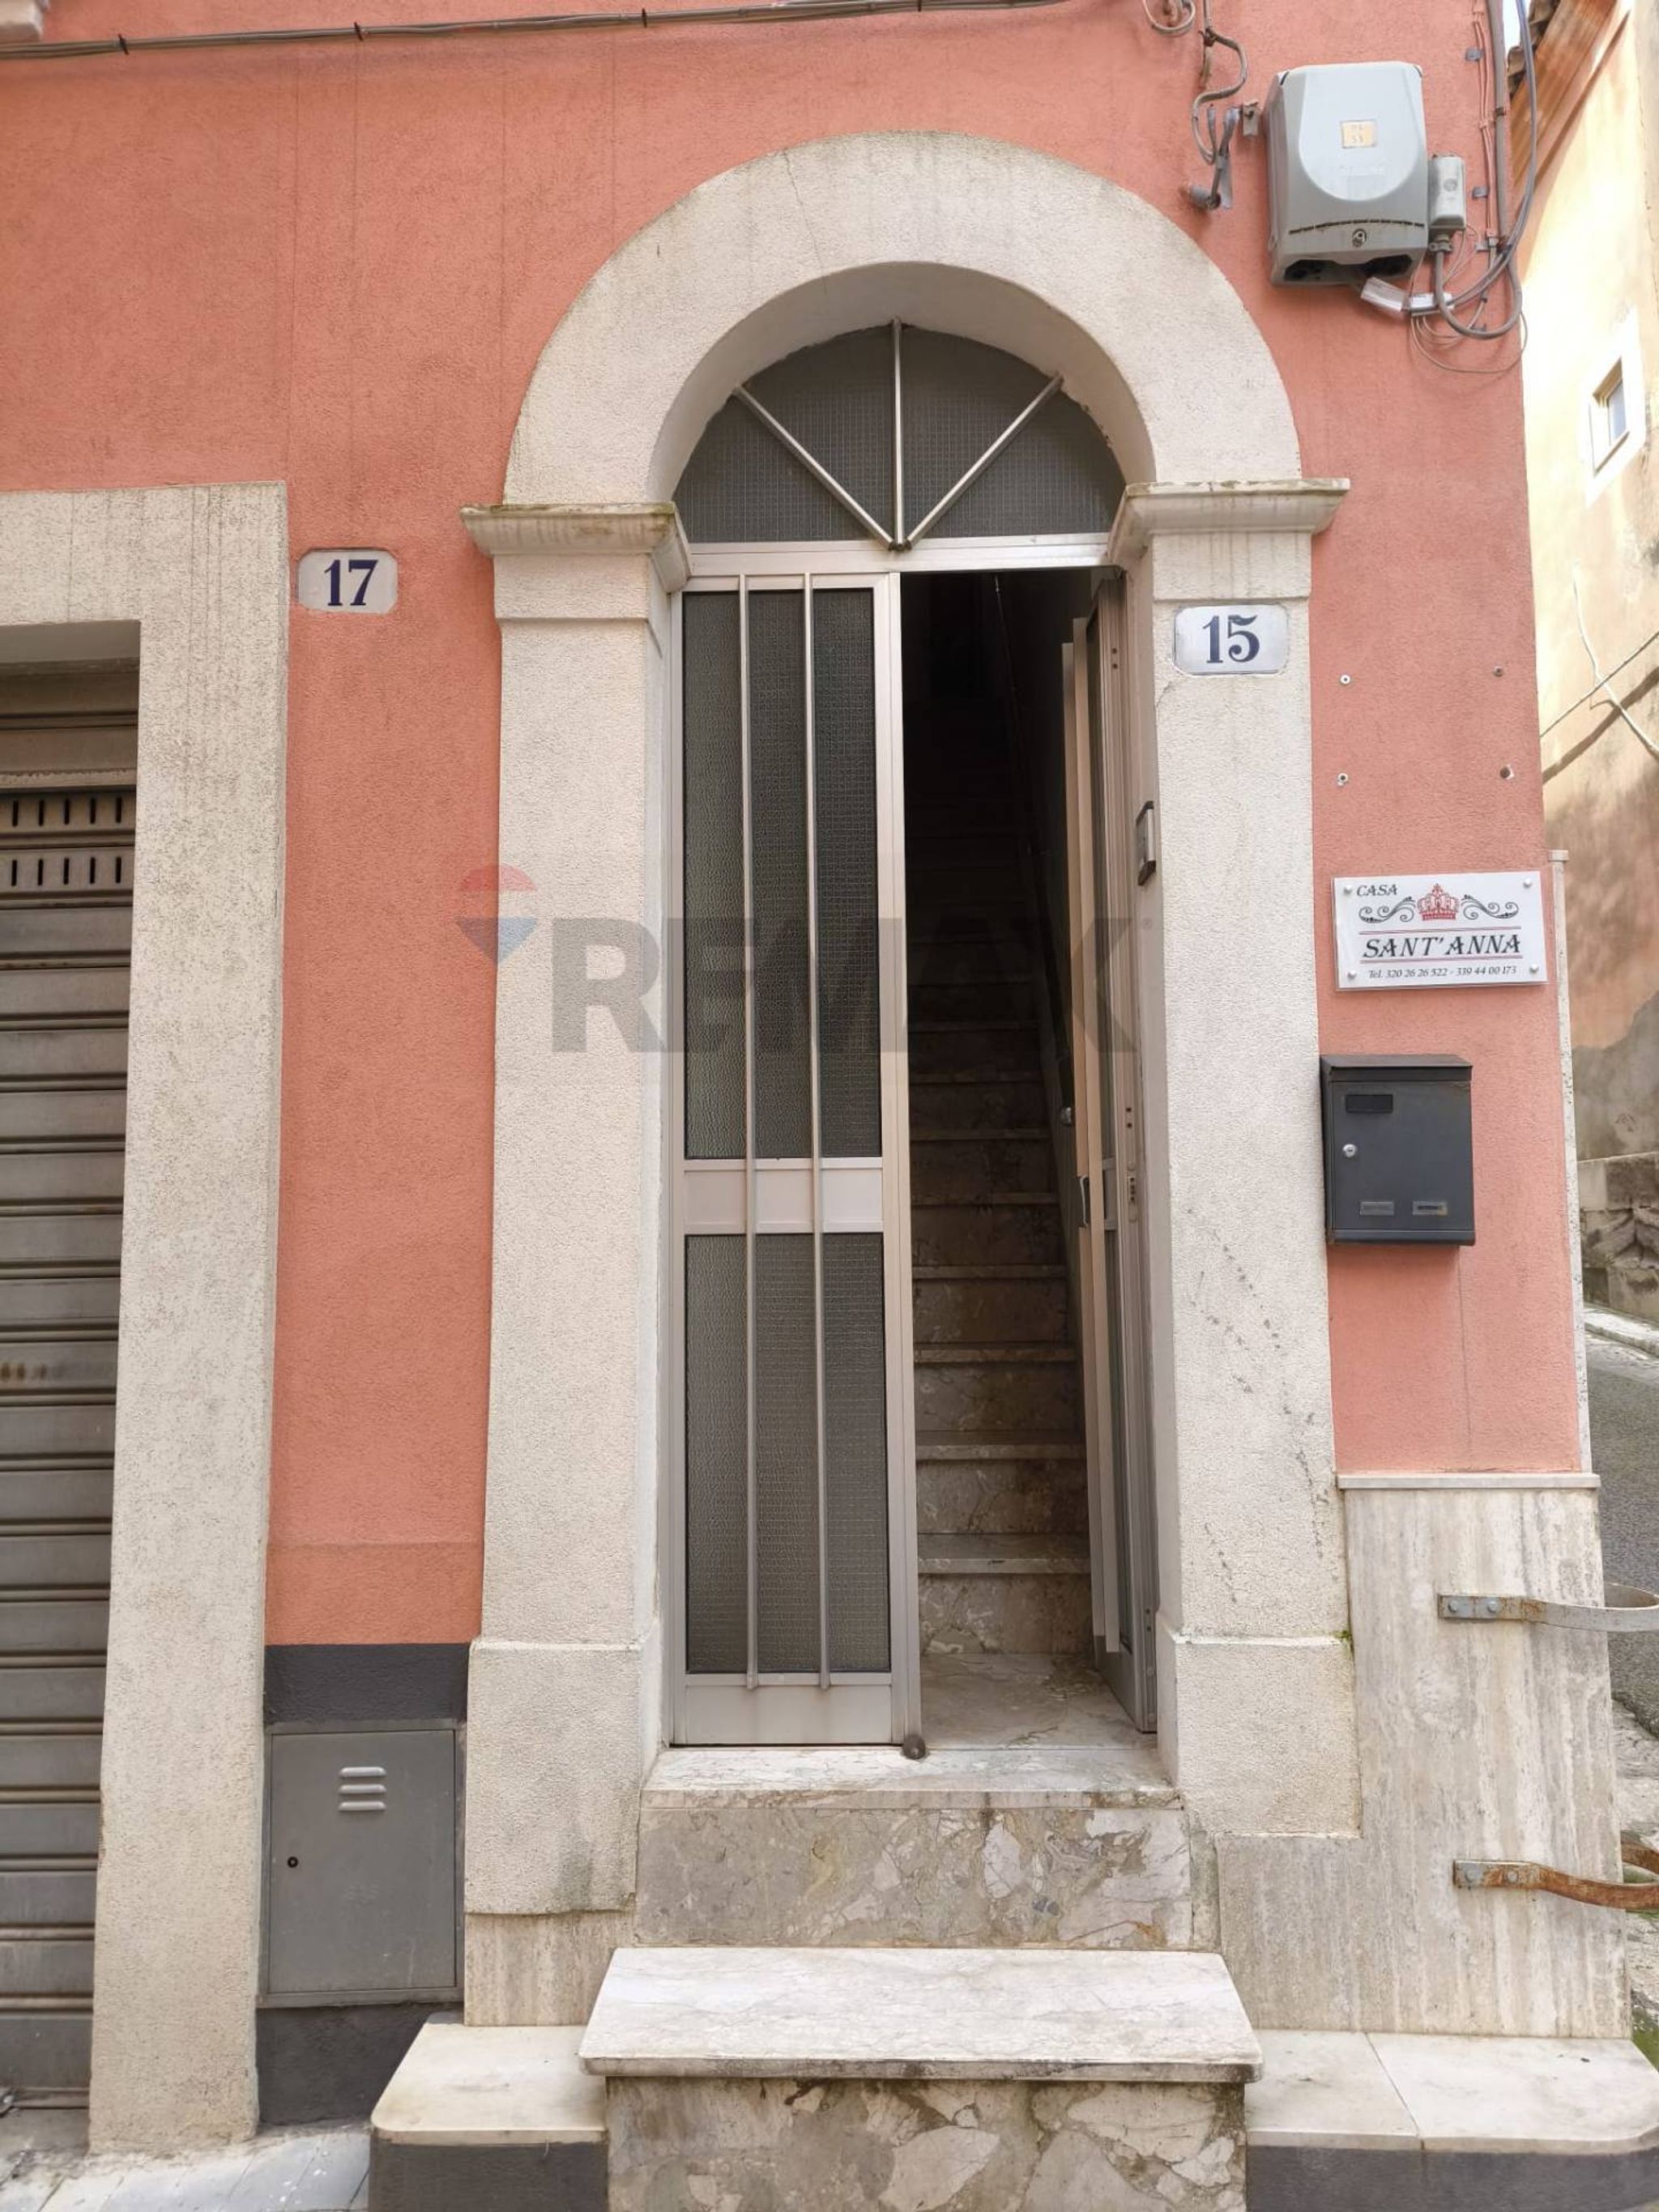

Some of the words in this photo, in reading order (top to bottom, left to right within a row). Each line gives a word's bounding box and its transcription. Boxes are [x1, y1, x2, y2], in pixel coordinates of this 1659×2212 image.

[324, 559, 379, 607] 17
[1202, 615, 1261, 664] 15
[1356, 884, 1398, 897] CASA
[1363, 934, 1521, 958] SANT'ANNA
[1369, 970, 1383, 978] Tel.
[1387, 970, 1402, 978] 320
[1405, 969, 1416, 978] 26
[1418, 968, 1430, 978] 26
[1431, 968, 1448, 977] 522
[1456, 967, 1472, 976] 339
[1473, 966, 1486, 975] 44
[1488, 965, 1500, 975] 00
